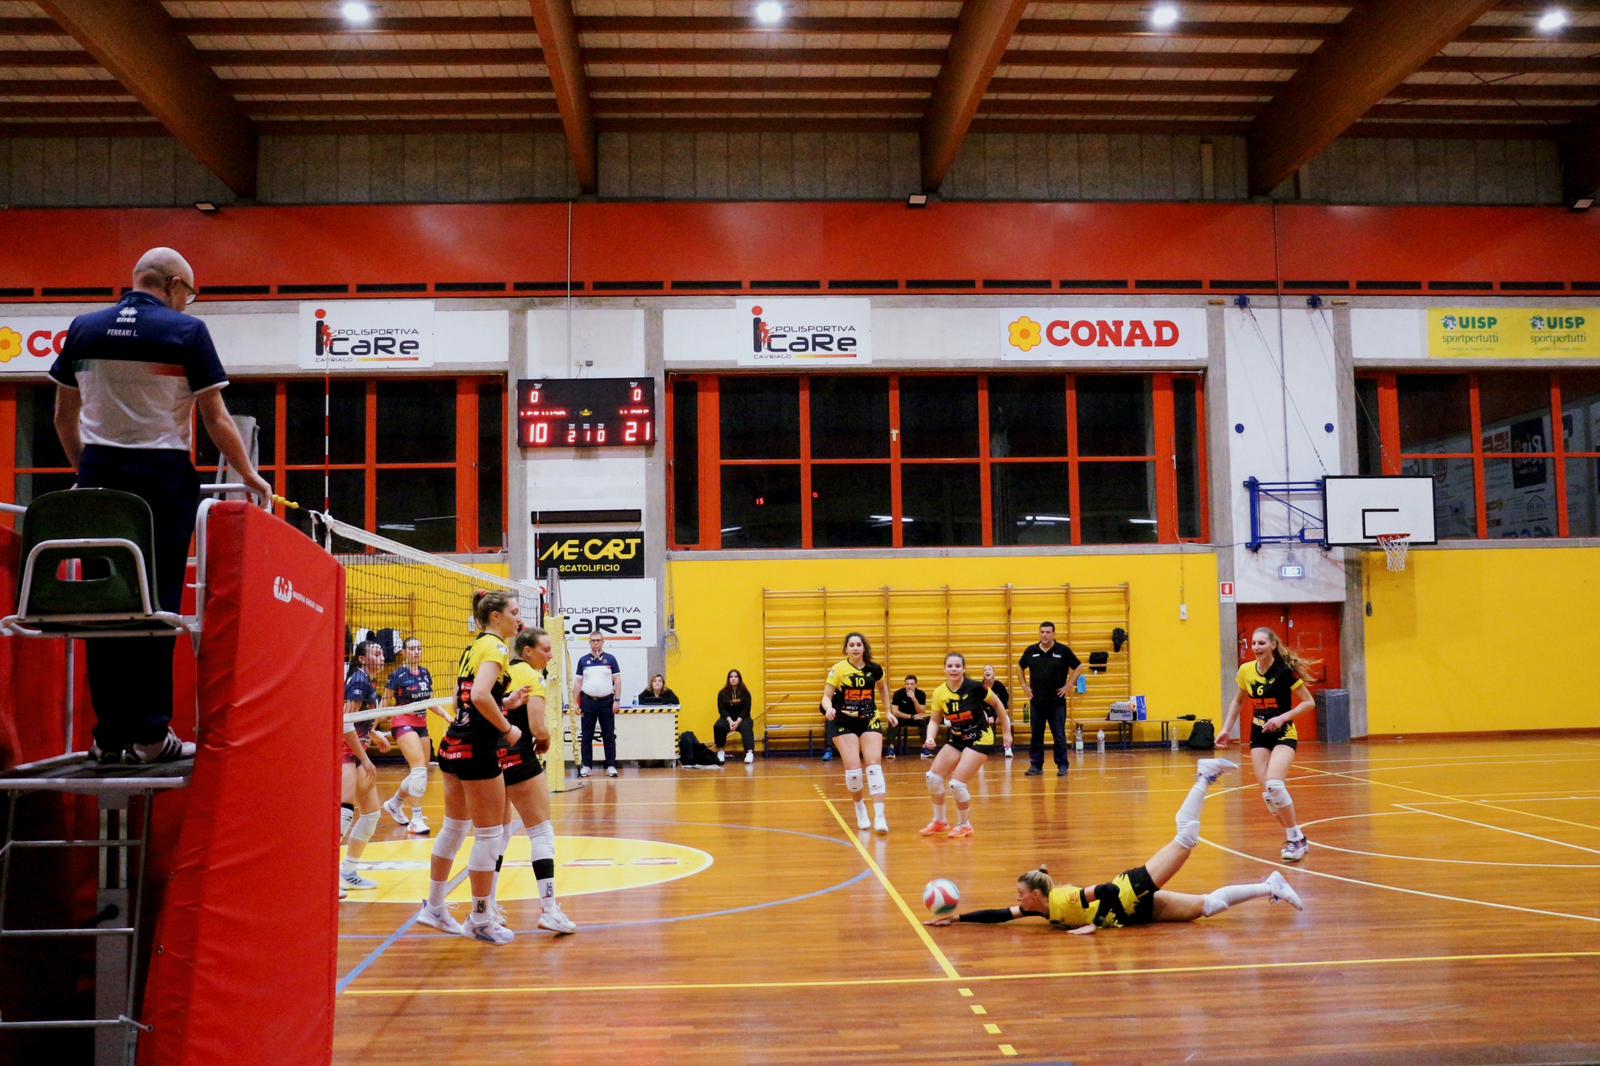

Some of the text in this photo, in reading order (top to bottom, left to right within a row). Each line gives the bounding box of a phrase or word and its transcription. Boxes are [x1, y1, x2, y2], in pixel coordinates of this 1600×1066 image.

[1458, 316, 1498, 329] UISP
[1546, 316, 1585, 329] UISP
[107, 328, 132, 337] FERRARI
[338, 328, 419, 336] POLISPORTIVA
[775, 325, 857, 333] POLISPORTIVA
[1046, 320, 1179, 347] CONAD
[530, 391, 539, 403] 0
[633, 389, 641, 401] 0
[529, 422, 548, 443] 10
[567, 430, 576, 443] 2
[597, 430, 605, 443] 0
[625, 421, 651, 442] 21
[559, 564, 620, 573] SCATOLIFICIO
[558, 607, 641, 615] POLISPORTIVA
[855, 677, 865, 687] 10
[1256, 685, 1264, 696] 6
[952, 702, 960, 711] 11
